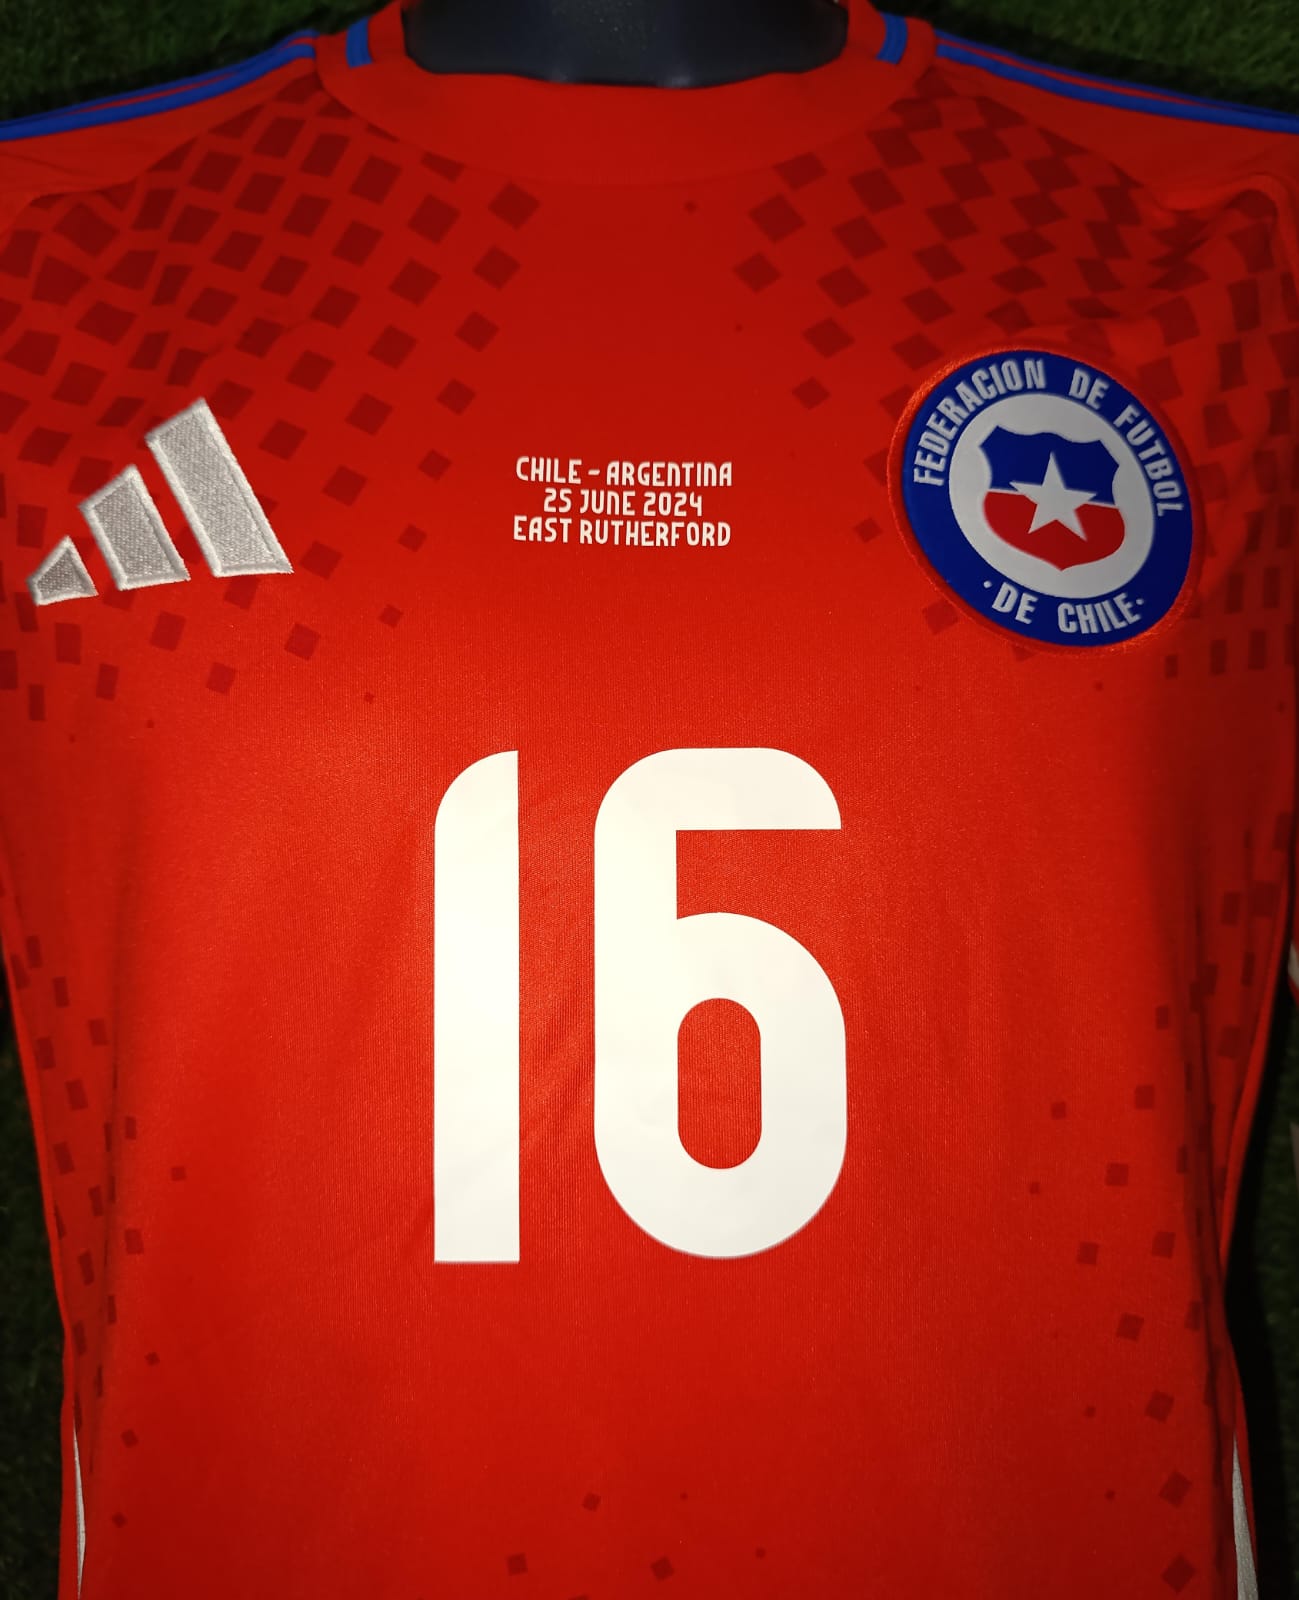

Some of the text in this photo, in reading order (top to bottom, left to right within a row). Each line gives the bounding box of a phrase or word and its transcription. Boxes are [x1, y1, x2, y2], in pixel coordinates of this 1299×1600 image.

[913, 359, 1184, 517] FEDERACION DE FUTBOL
[516, 456, 582, 484] CHILE
[606, 461, 732, 487] ARGENTINA
[543, 488, 703, 517] 25 JUNE 2024
[513, 515, 731, 547] EAST RUTHERFORD
[991, 582, 1141, 635] DE CHILE
[434, 747, 848, 1264] 16
